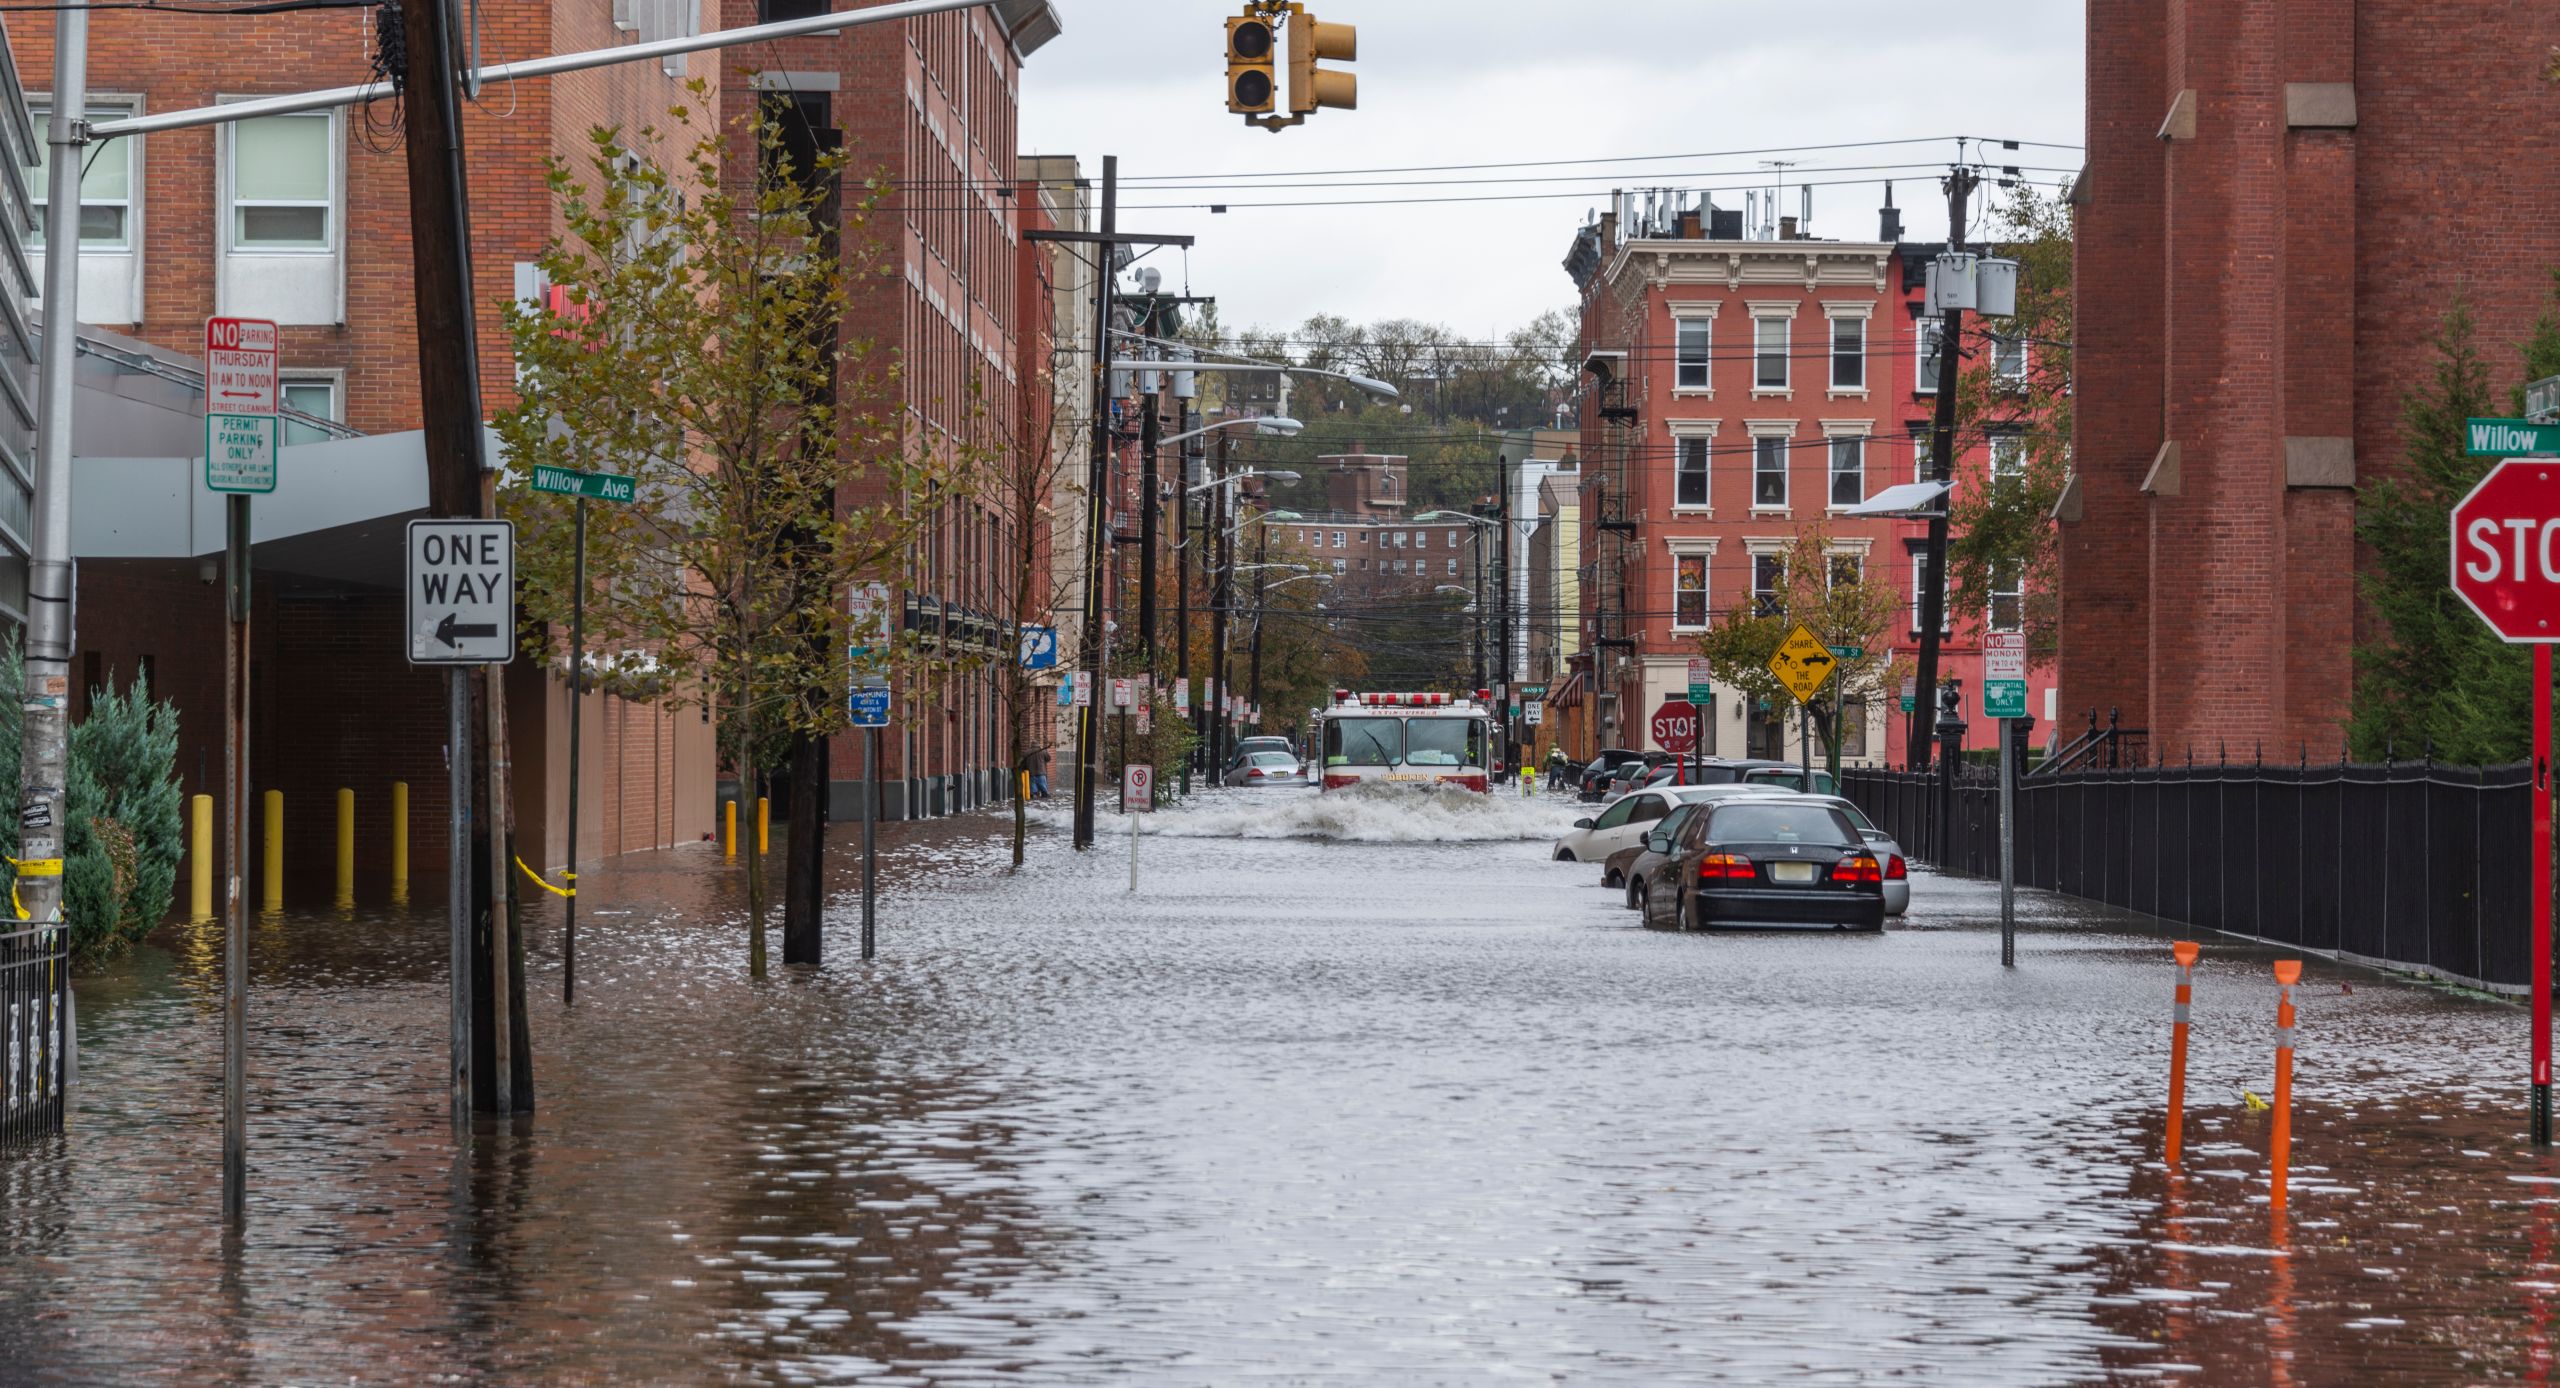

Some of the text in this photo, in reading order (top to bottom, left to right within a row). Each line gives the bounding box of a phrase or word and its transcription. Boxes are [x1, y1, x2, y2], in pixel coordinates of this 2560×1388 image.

[212, 323, 273, 346] NO PARKING
[213, 352, 270, 367] THURSDAY
[212, 372, 272, 388] 11 AM TO NOON
[212, 403, 272, 413] STREET CLEANING
[223, 418, 260, 431] PERMIT
[220, 433, 263, 447] PARKING
[2472, 424, 2538, 450] Willow
[228, 447, 254, 459] ONLY
[537, 469, 629, 498] Willow Ave
[423, 534, 498, 565] ONE
[2466, 517, 2560, 583] STO
[422, 573, 502, 604] WAY
[863, 588, 878, 598] NO
[1790, 640, 1814, 649] SHARE
[1987, 636, 2001, 647] NO
[1851, 648, 1858, 656] St
[1796, 671, 1810, 680] THE
[1794, 683, 1813, 691] ROAD
